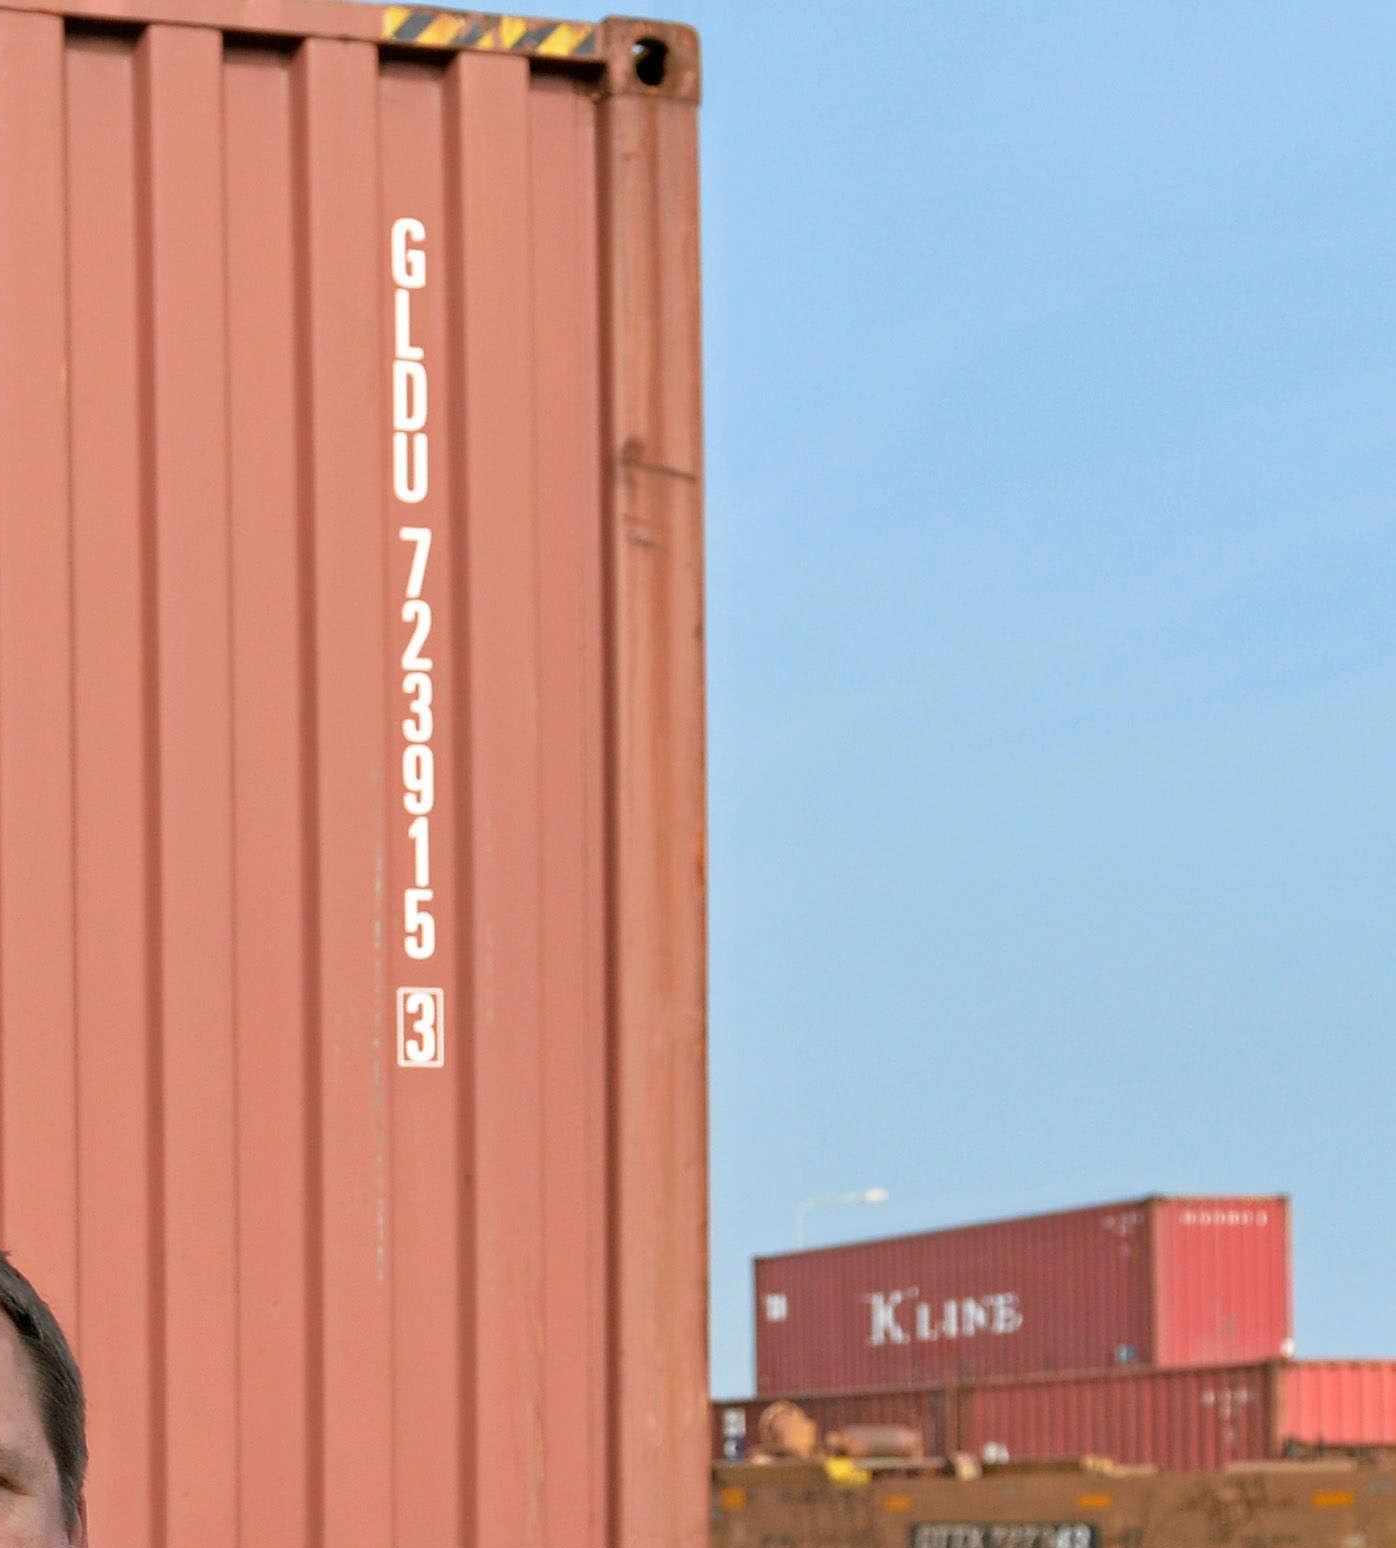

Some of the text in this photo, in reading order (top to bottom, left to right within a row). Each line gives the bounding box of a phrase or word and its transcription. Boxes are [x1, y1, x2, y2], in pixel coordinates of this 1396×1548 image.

[391, 217, 437, 1064] GLDU 723915 3
